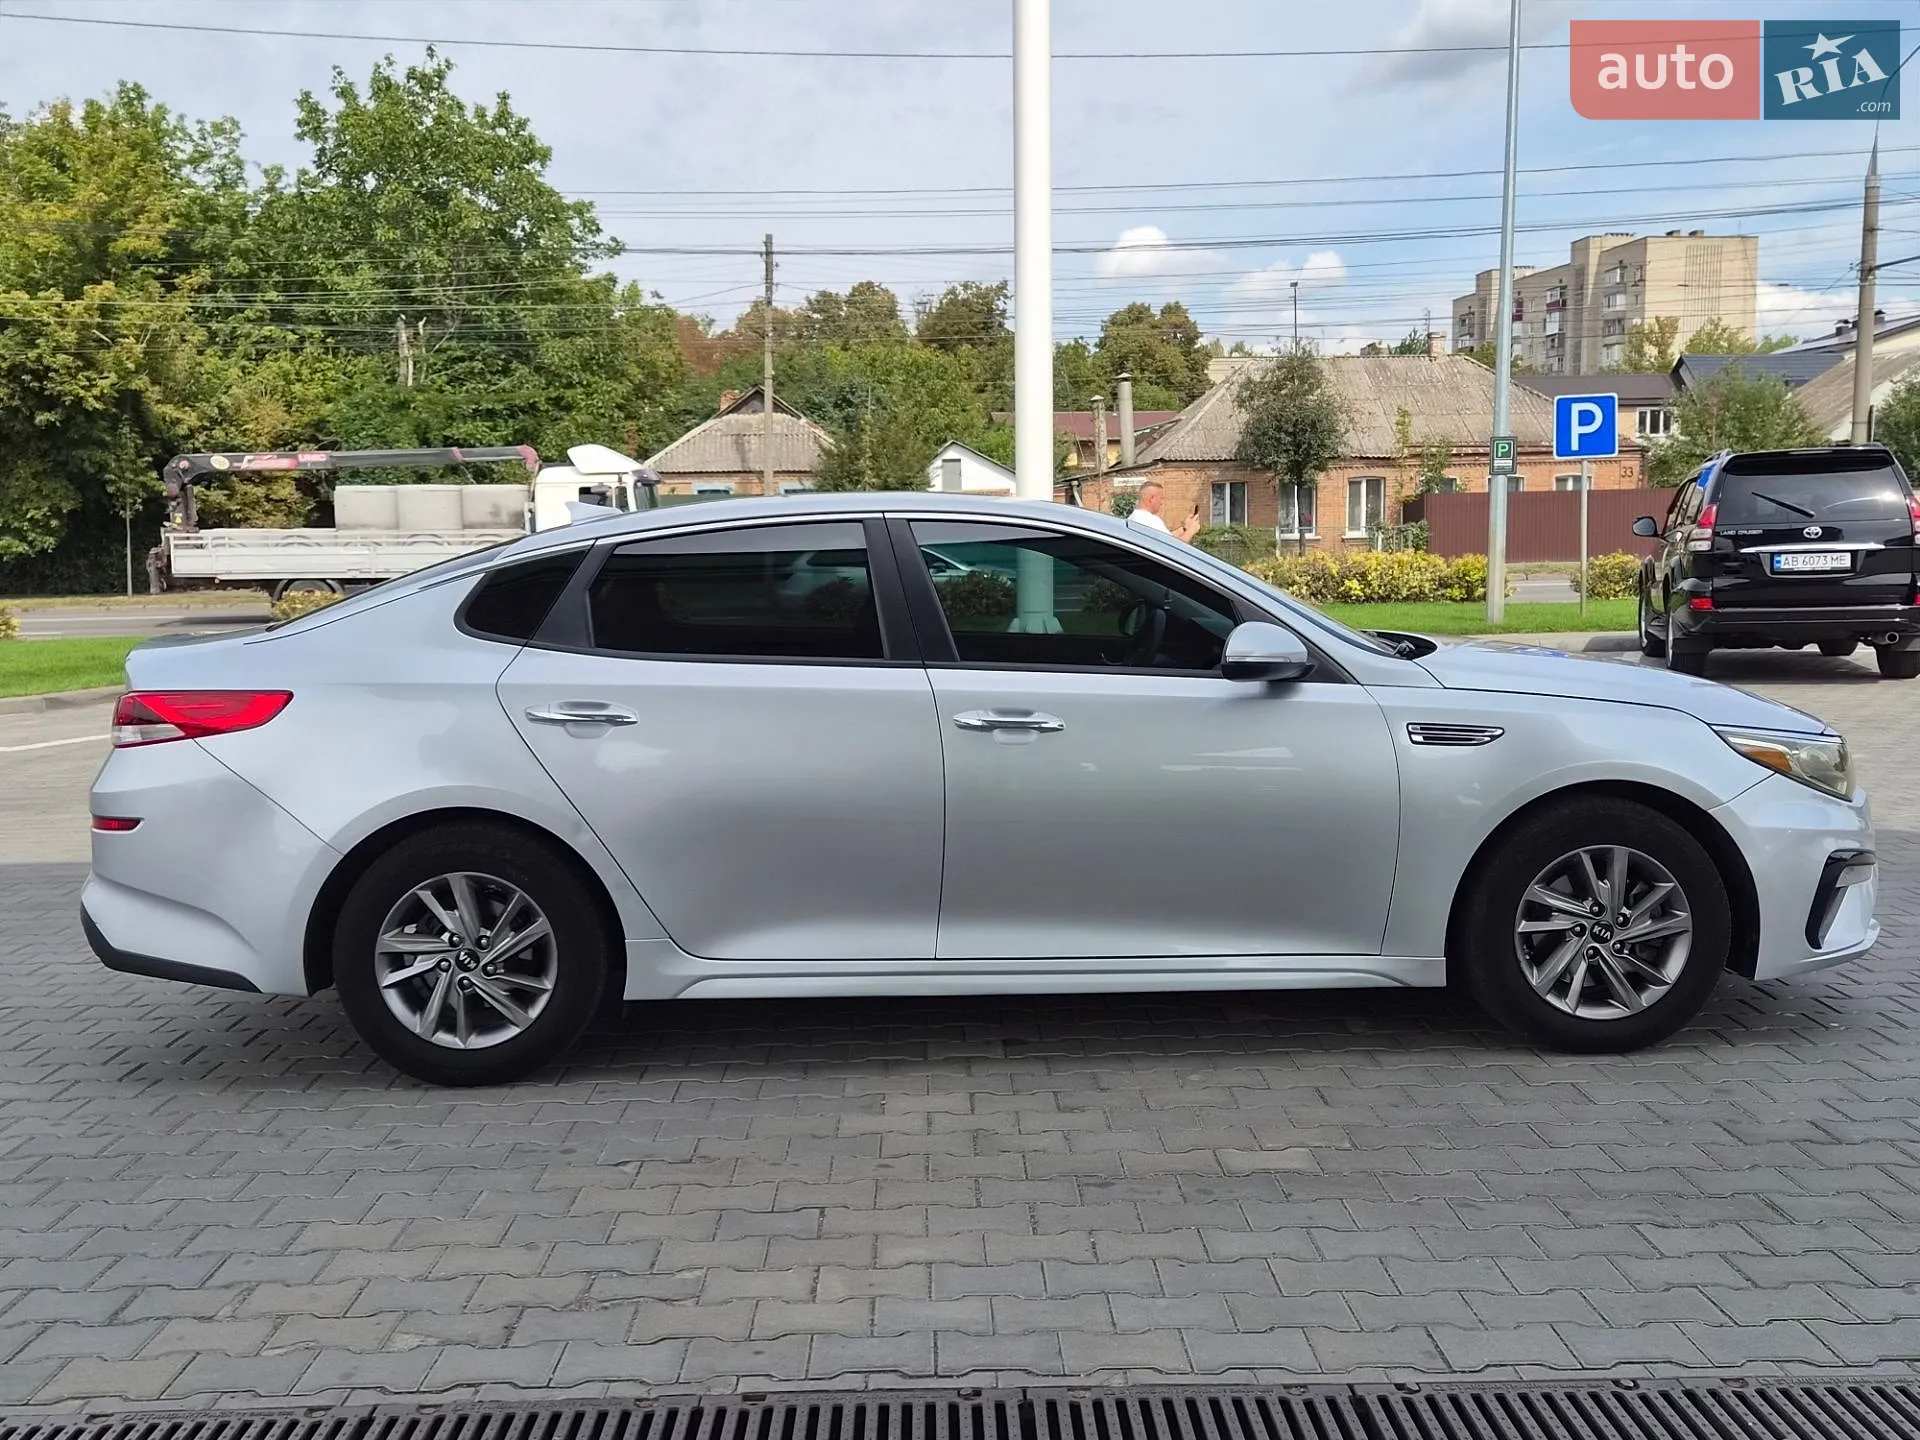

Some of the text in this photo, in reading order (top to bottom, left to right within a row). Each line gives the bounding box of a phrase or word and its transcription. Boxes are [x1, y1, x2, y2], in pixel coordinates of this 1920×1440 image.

[1571, 402, 1604, 451] P
[1498, 443, 1509, 457] P
[1621, 466, 1633, 478] 33
[1783, 554, 1847, 567] AB 6073 ME
[1593, 925, 1610, 940] KIA
[459, 951, 477, 970] KIA
